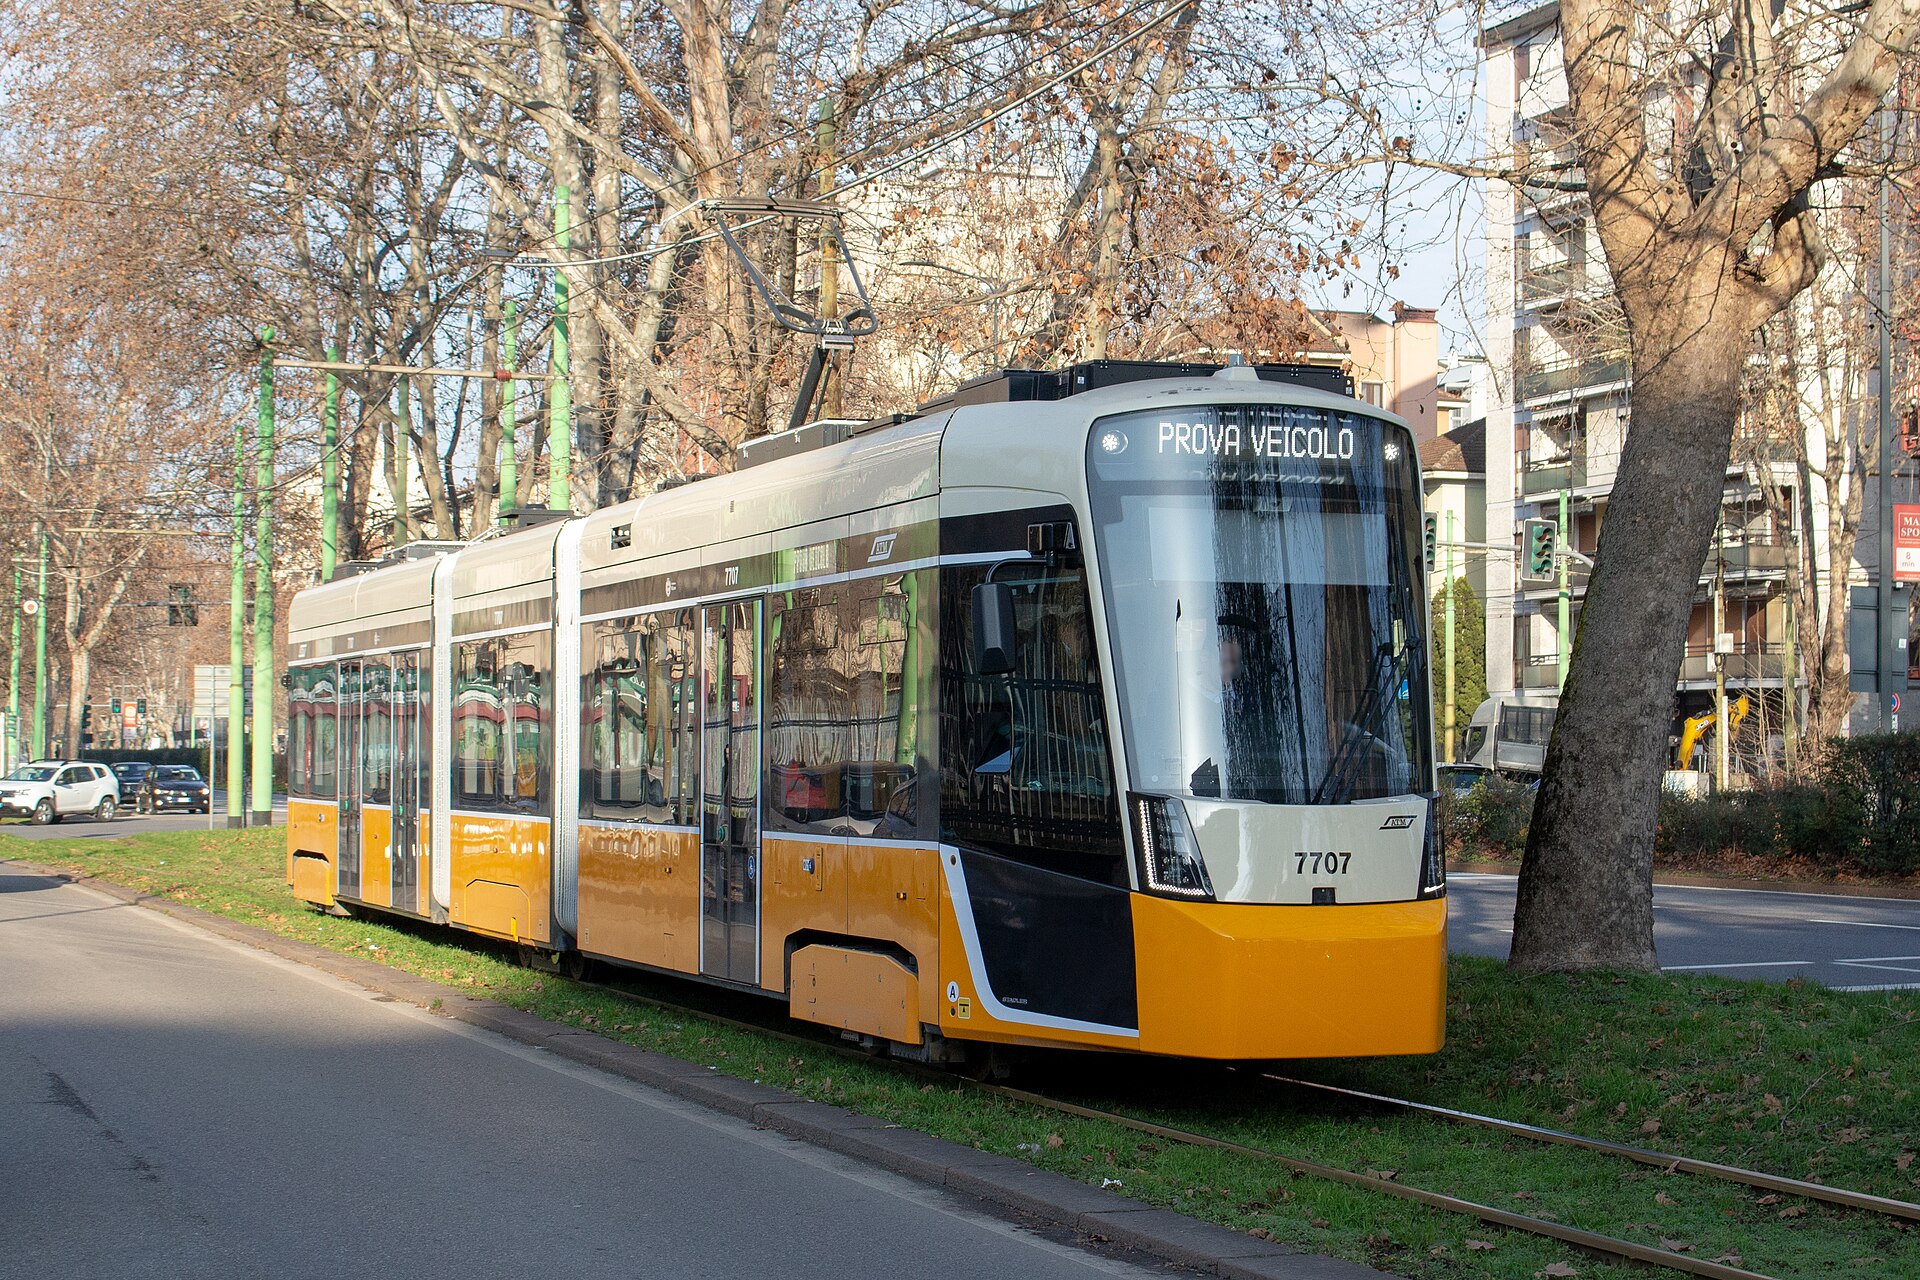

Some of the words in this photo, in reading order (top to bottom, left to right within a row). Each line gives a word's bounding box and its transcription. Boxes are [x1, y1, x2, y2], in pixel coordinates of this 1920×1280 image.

[1159, 421, 1240, 456] PROVA
[1251, 425, 1354, 459] VEICOLO
[724, 566, 739, 586] 7707
[1294, 851, 1352, 875] 7707
[949, 985, 957, 999] A
